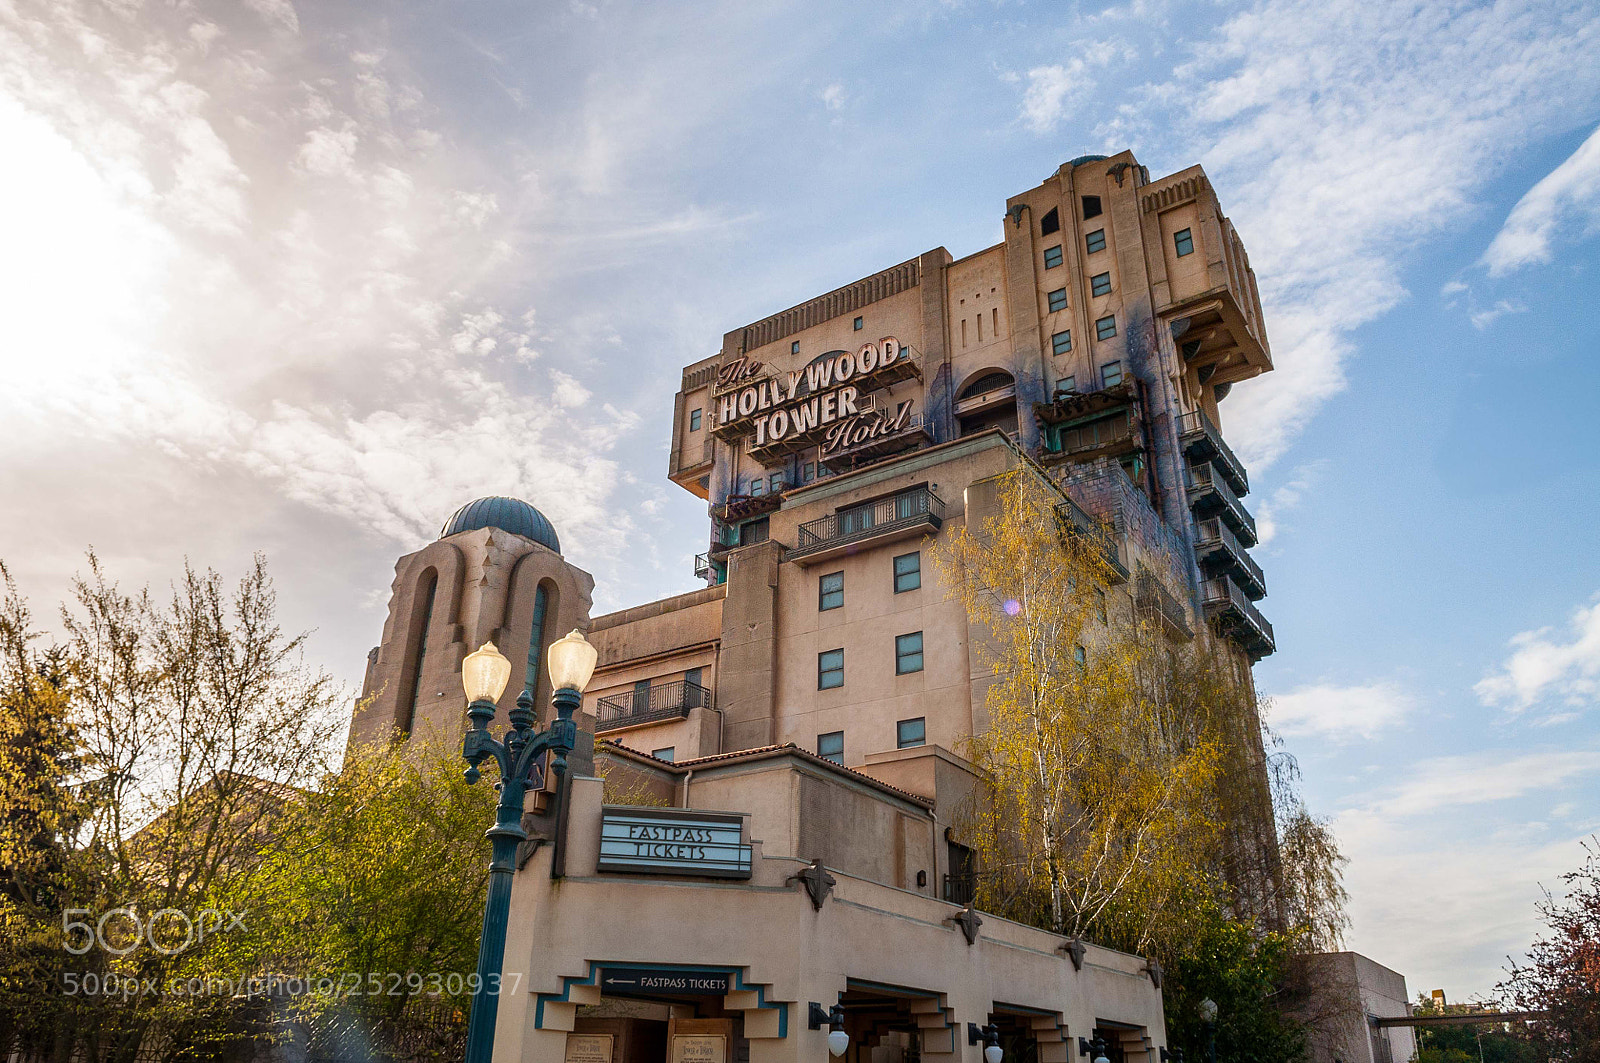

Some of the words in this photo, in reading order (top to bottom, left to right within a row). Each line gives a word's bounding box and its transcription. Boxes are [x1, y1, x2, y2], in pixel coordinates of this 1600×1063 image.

[717, 356, 763, 386] The
[720, 336, 901, 425] HOLLYWOOD
[753, 386, 860, 446] TOWER
[821, 398, 914, 453] Hotel
[629, 825, 712, 843] FASTPASS
[633, 843, 706, 860] TICKETS
[640, 977, 686, 988] FASTPASS
[688, 979, 726, 990] TICKETS
